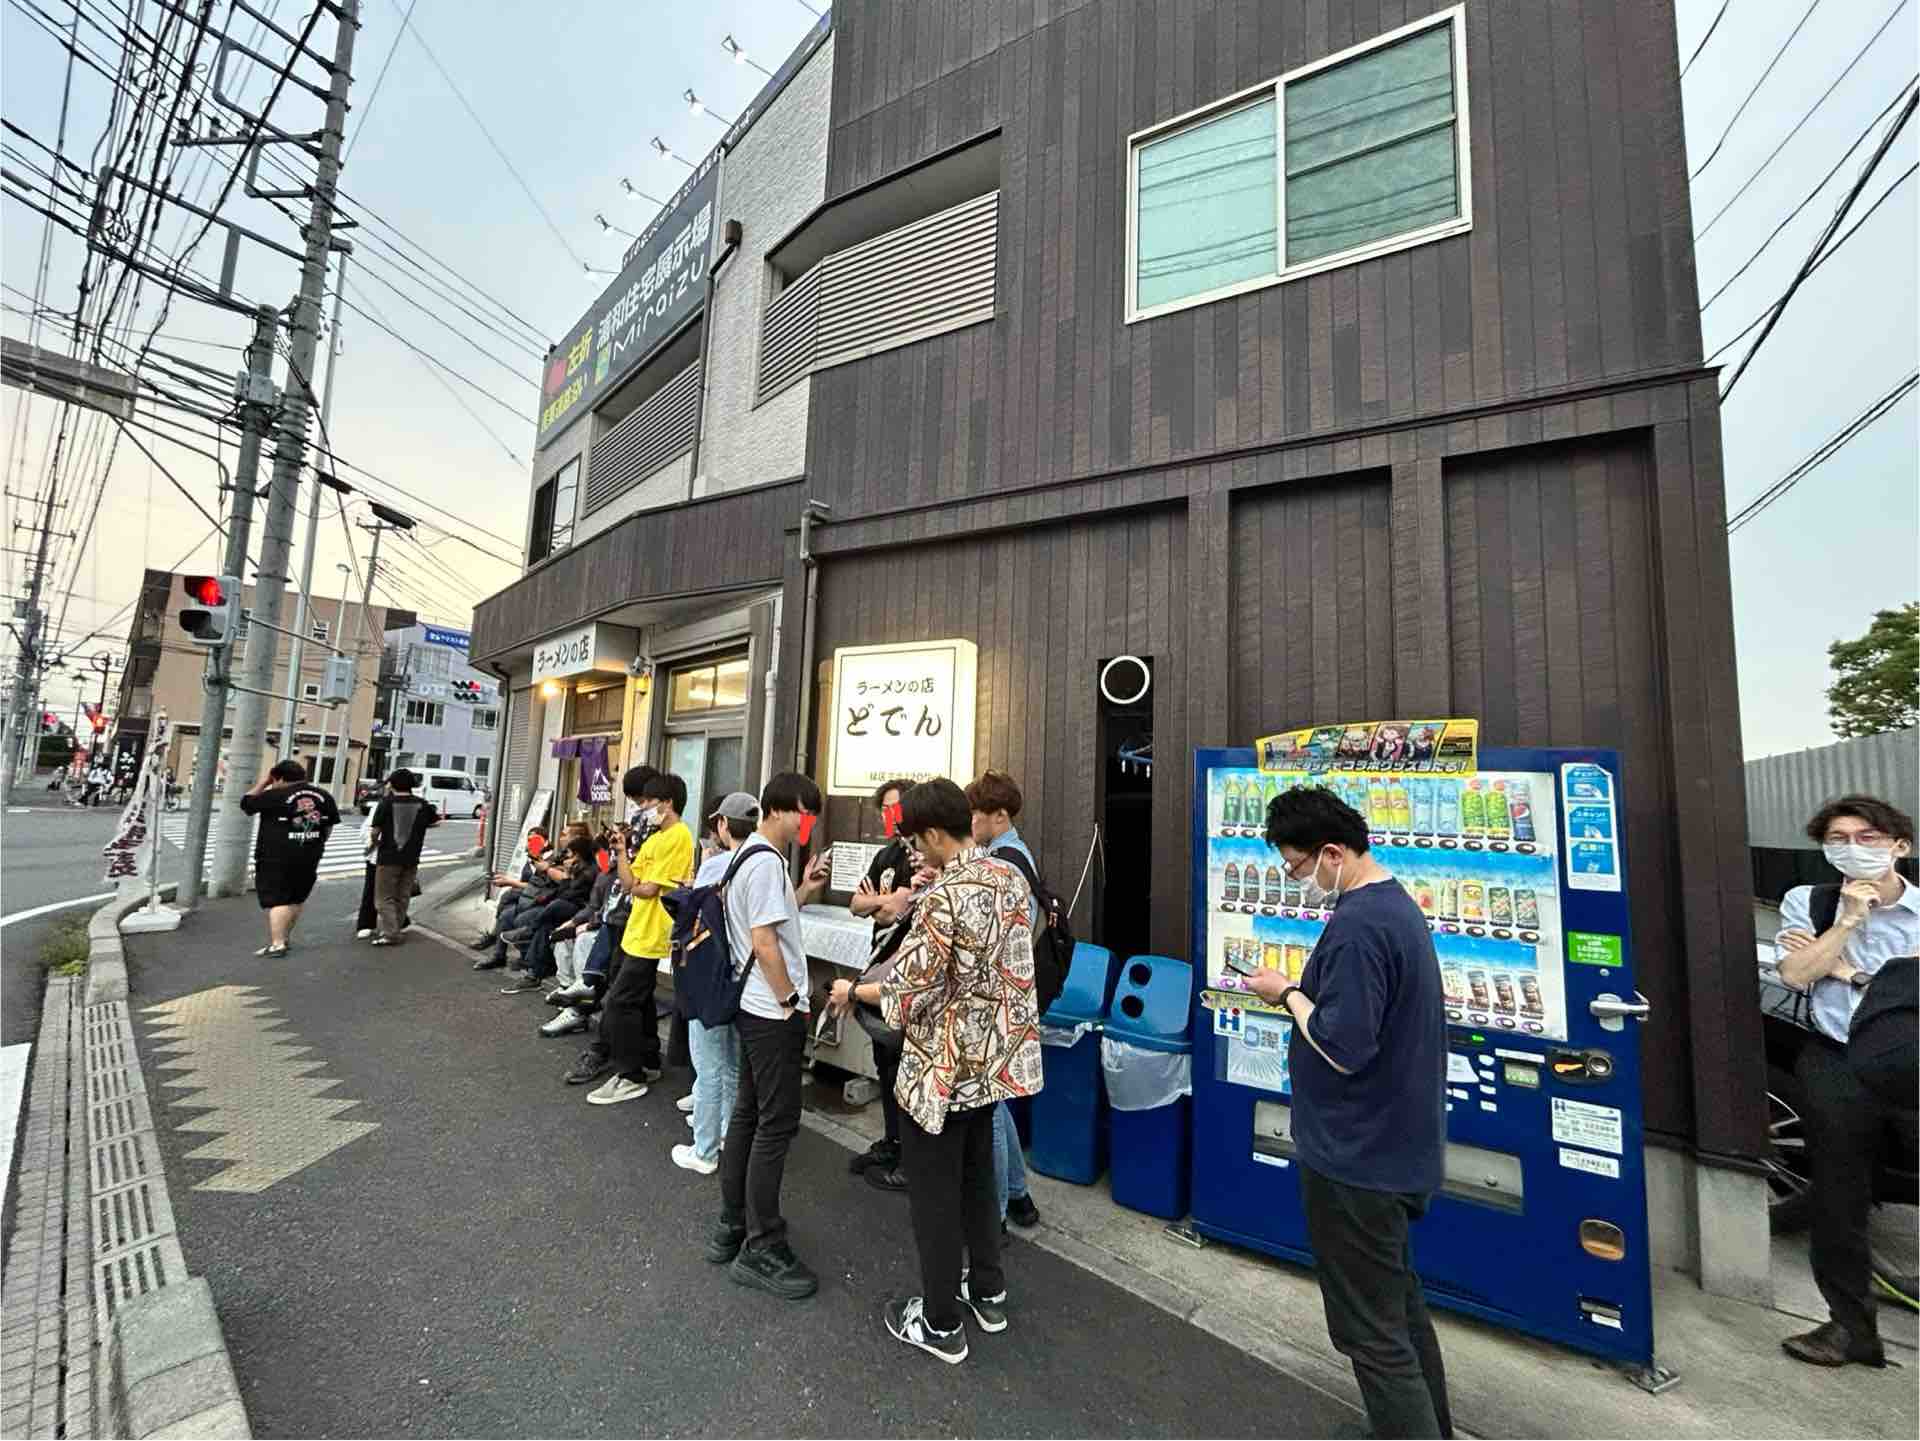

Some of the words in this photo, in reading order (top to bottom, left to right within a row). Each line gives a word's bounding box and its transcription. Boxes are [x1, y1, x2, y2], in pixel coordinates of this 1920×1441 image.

[537, 634, 590, 673] ラーメンの店
[856, 677, 937, 695] ラーメンの店
[846, 704, 942, 737] どでん
